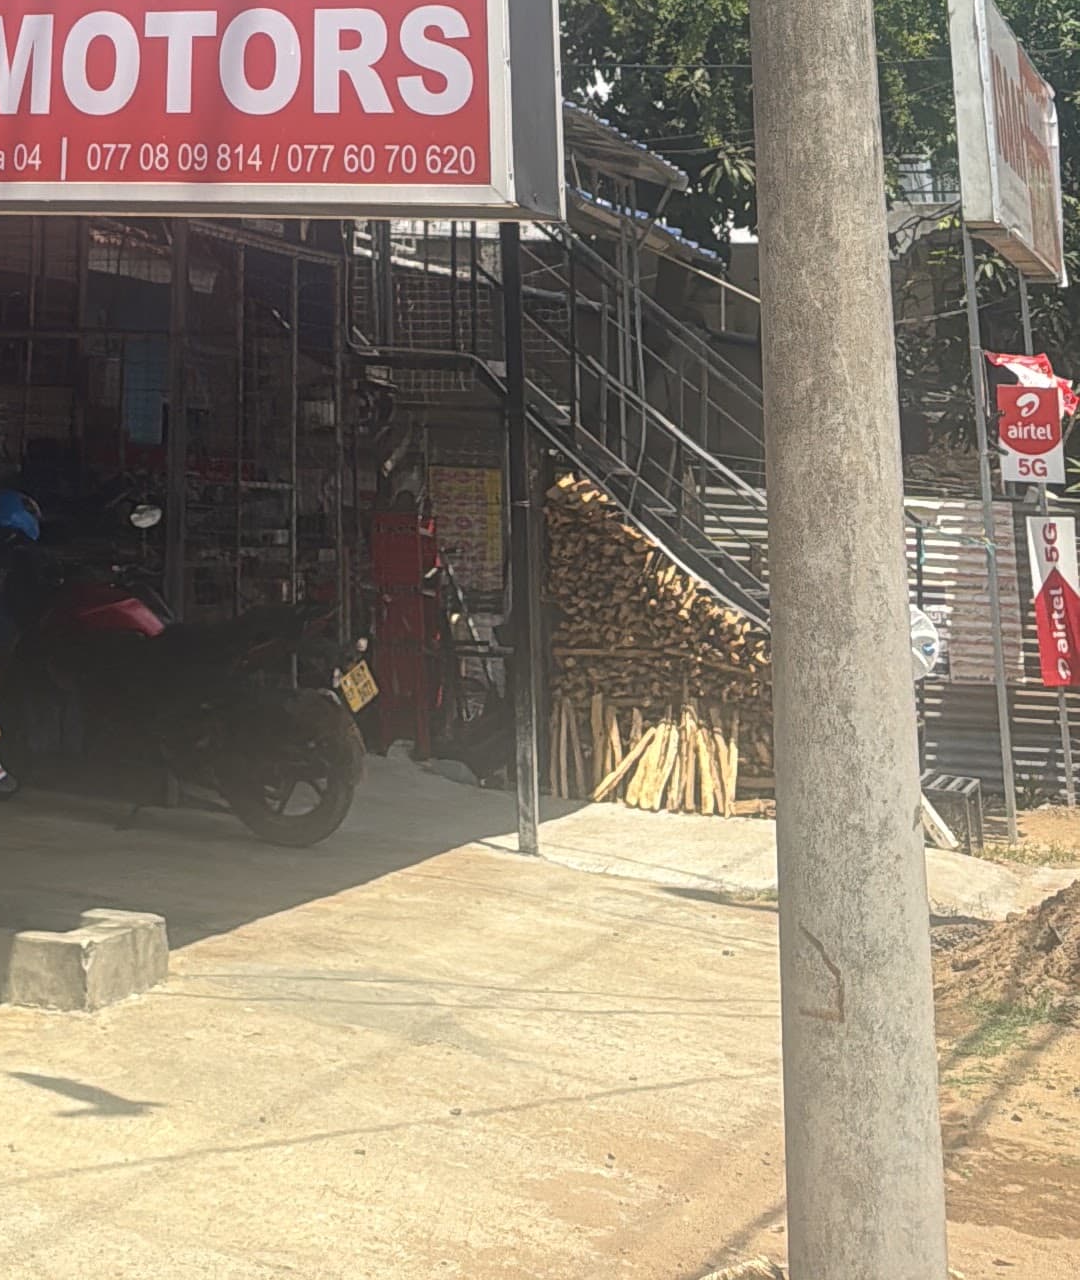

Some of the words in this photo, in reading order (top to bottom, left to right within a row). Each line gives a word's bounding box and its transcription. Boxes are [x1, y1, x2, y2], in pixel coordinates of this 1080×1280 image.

[13, 143, 42, 171] 04
[87, 143, 131, 172] 077
[139, 143, 169, 171] 08
[177, 143, 208, 171] 09
[216, 143, 262, 172] 814
[270, 144, 279, 172] /
[287, 144, 335, 173] 077
[343, 144, 375, 174] 60
[384, 144, 416, 175] 70
[425, 144, 476, 175] 620
[1007, 421, 1053, 440] airtel
[1018, 457, 1047, 477] 5G
[1044, 521, 1058, 562] 5G
[1052, 587, 1070, 652] airtel
